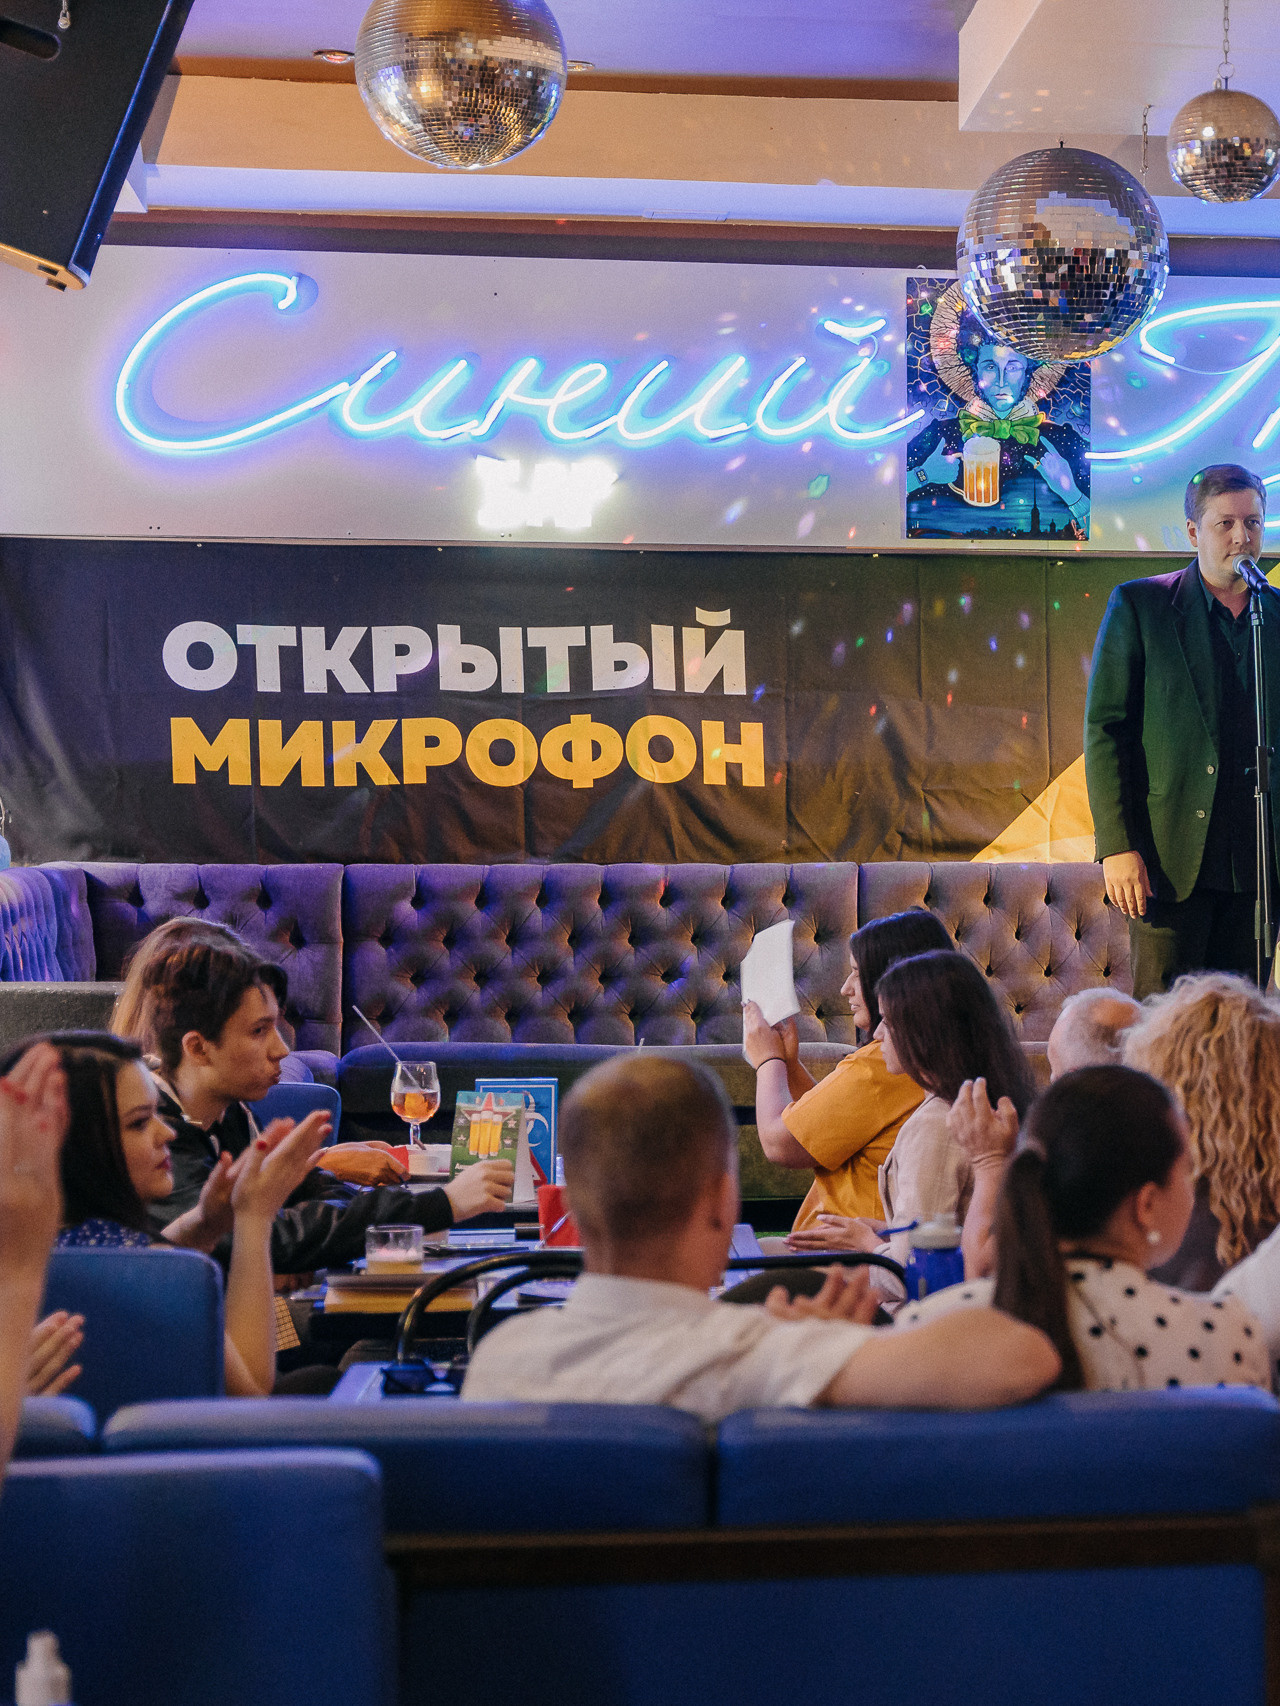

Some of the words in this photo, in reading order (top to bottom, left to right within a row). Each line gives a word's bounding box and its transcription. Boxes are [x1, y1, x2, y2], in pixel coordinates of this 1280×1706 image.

[115, 271, 925, 451] Синий
[162, 606, 747, 696] ОТКРЫТЫЙ
[170, 713, 766, 789] МИКРОФОН
